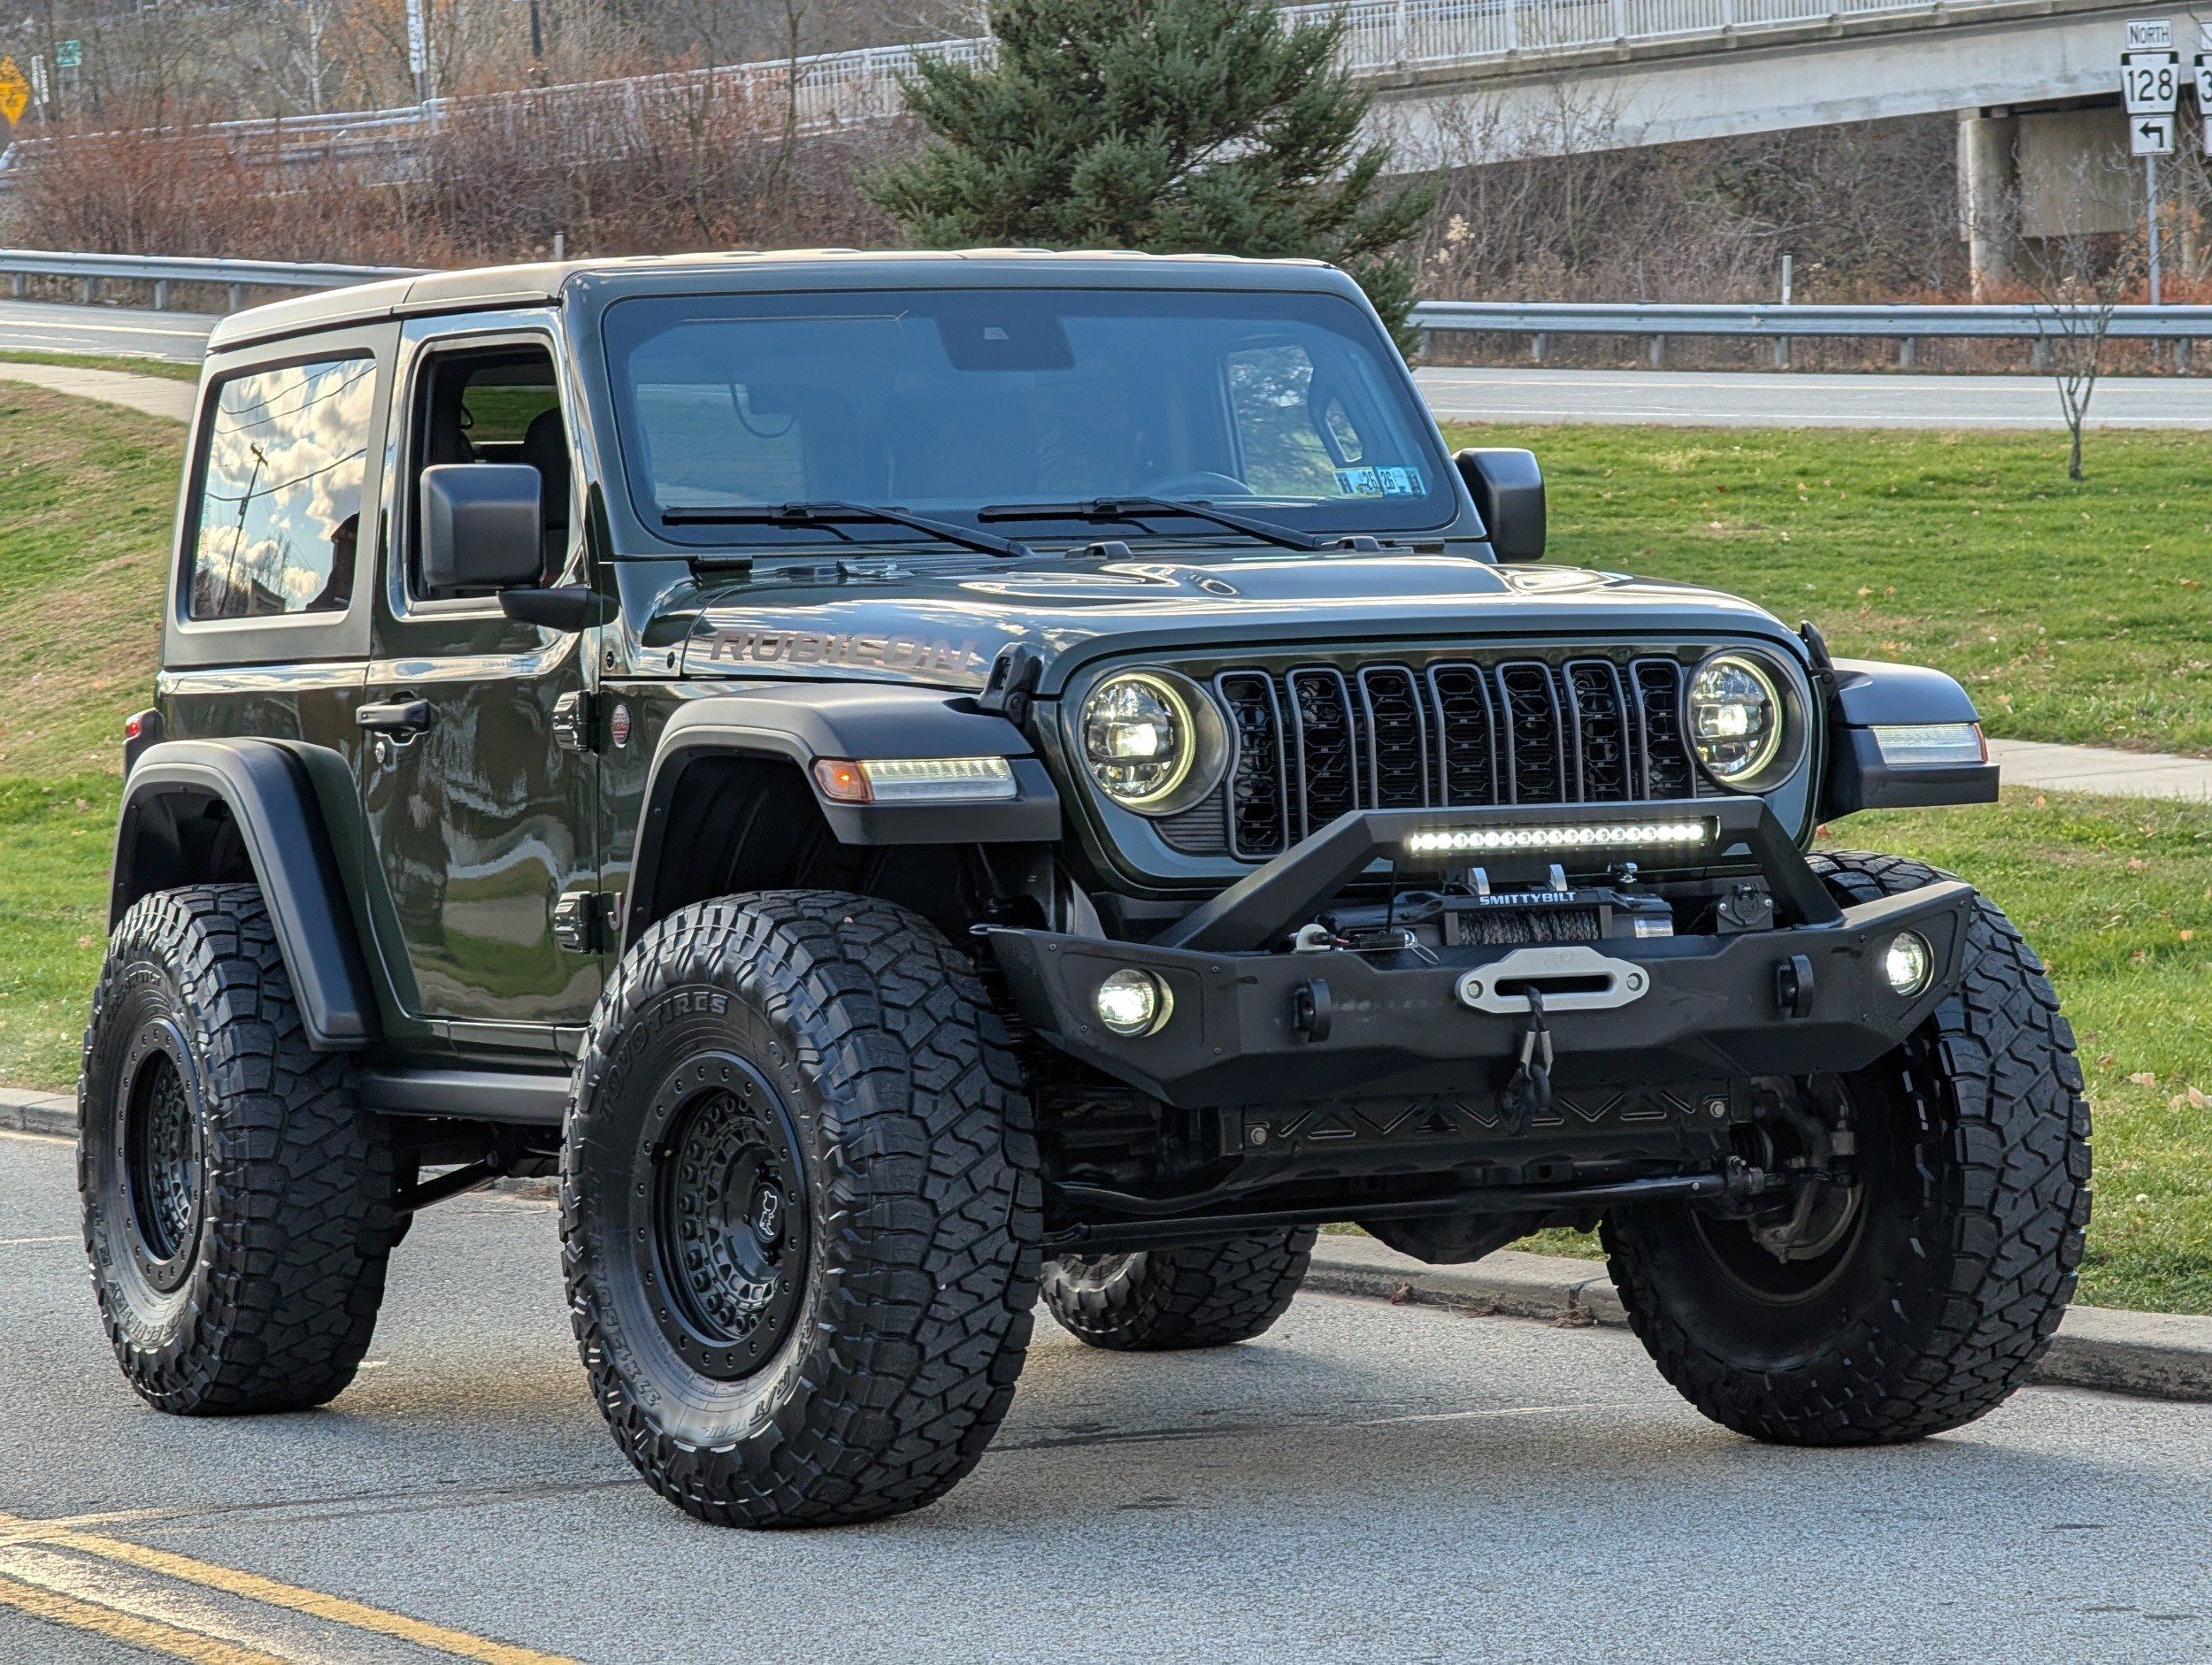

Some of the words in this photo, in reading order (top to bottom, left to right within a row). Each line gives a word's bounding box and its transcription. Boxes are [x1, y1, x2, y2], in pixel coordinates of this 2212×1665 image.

[2129, 25, 2169, 44] NORTH
[2128, 68, 2173, 102] 128
[710, 629, 978, 671] RUBICON
[1479, 892, 1576, 906] SMITTYBILT
[647, 991, 728, 1033] TIRES
